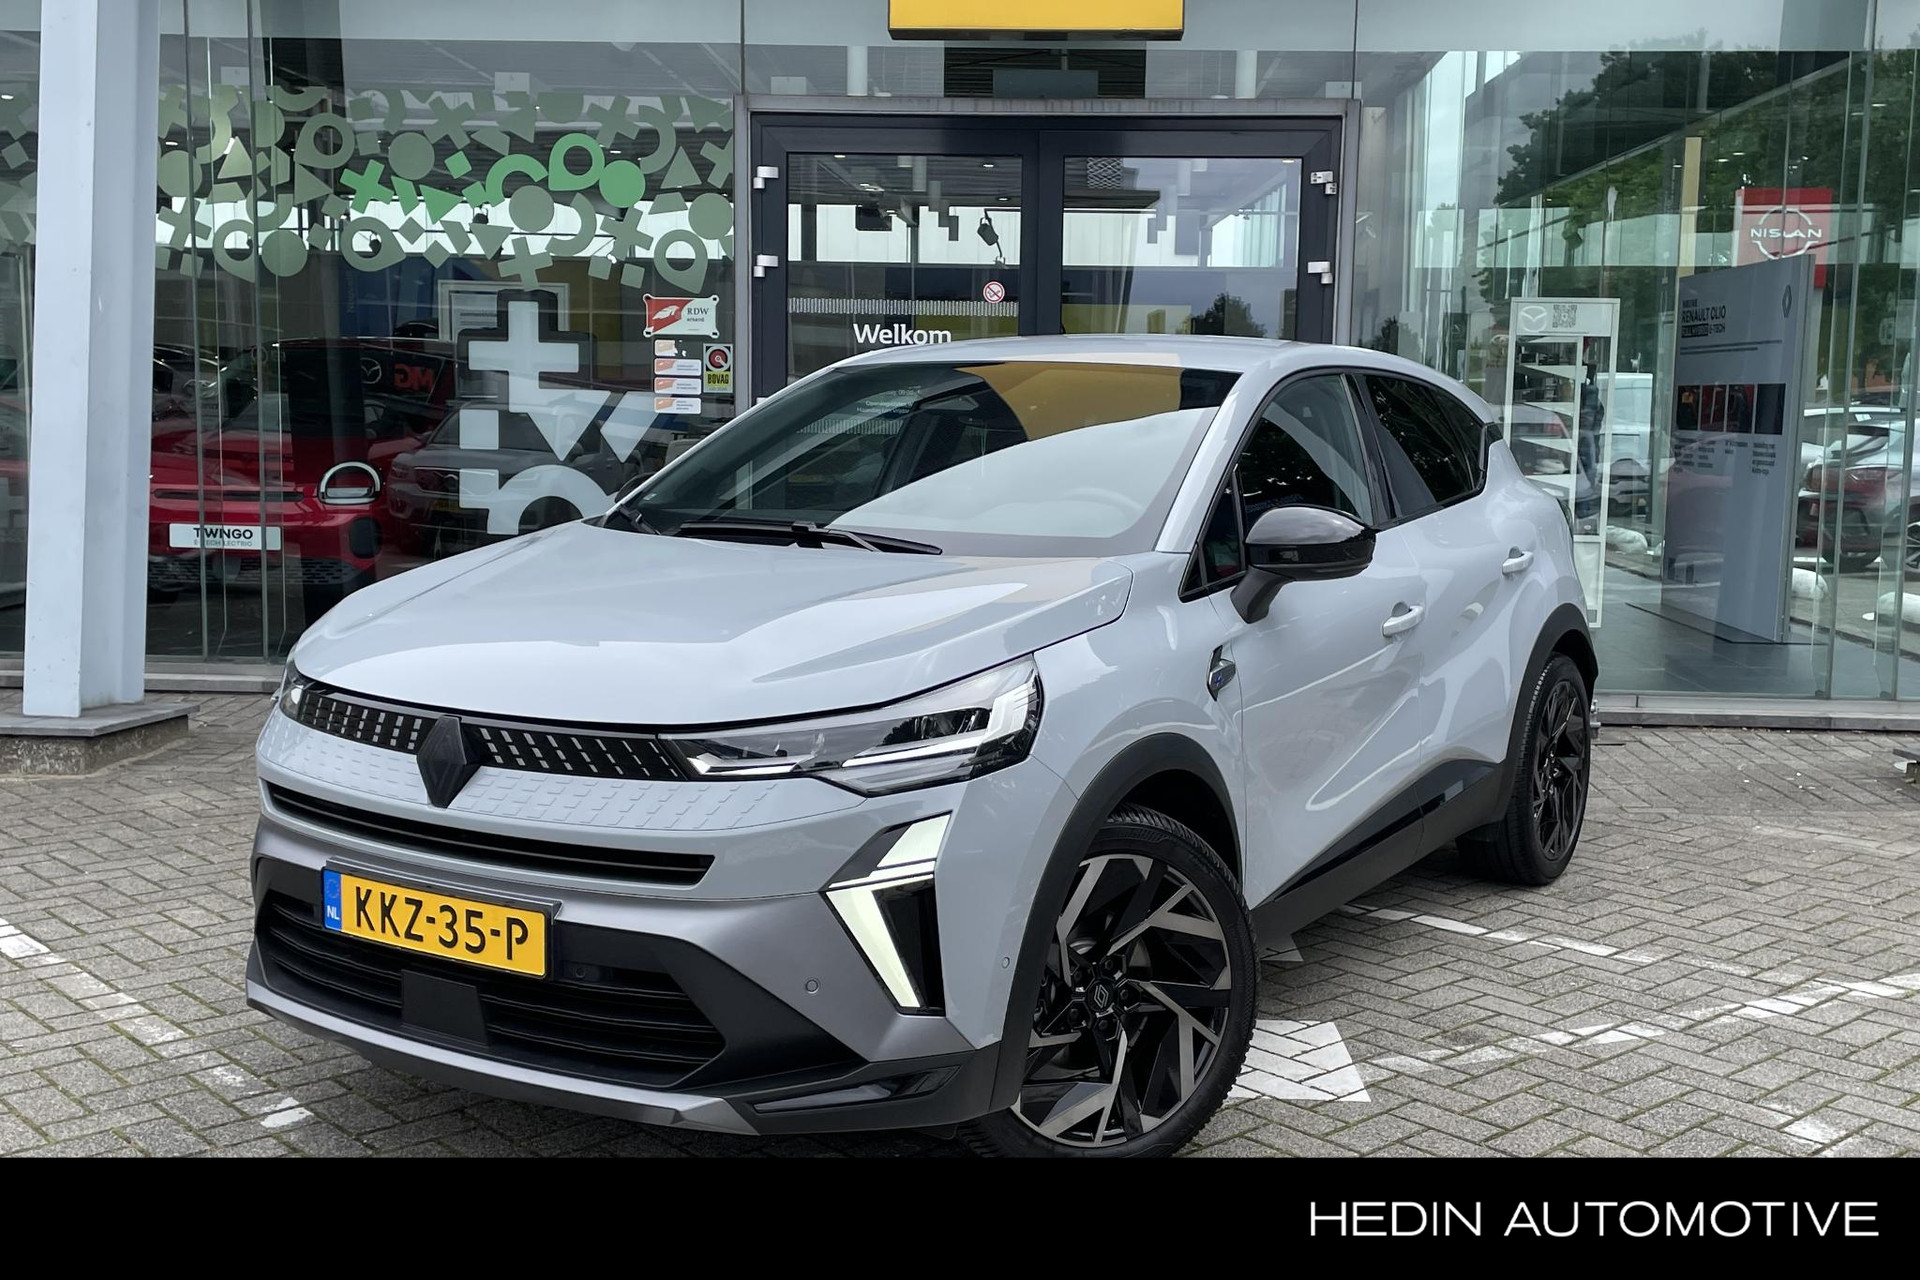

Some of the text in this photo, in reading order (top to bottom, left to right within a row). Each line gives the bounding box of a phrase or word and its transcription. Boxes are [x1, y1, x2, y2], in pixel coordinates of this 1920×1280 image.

[687, 307, 709, 315] RDW
[853, 323, 952, 345] Welkom
[707, 374, 729, 385] BOVAG
[327, 886, 529, 961] NL KKZ-35-P
